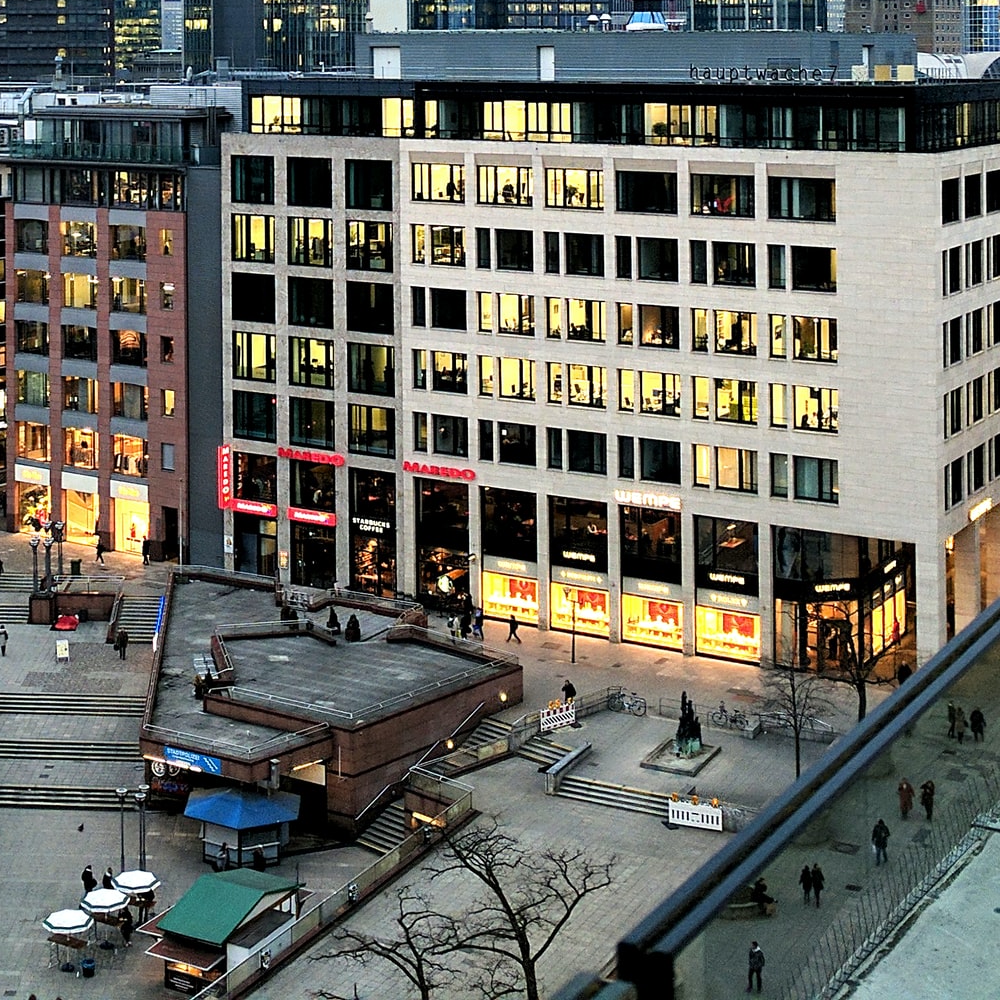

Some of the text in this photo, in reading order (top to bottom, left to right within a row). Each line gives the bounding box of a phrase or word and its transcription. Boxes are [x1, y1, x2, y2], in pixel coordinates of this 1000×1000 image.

[278, 447, 345, 466] MAREDO
[222, 446, 230, 493] MAREDO
[403, 461, 476, 480] MAREDO
[614, 490, 681, 509] WEMPE
[352, 517, 391, 529] STARBUCKS
[359, 524, 384, 534] COFFEE
[709, 573, 745, 585] WEMPE
